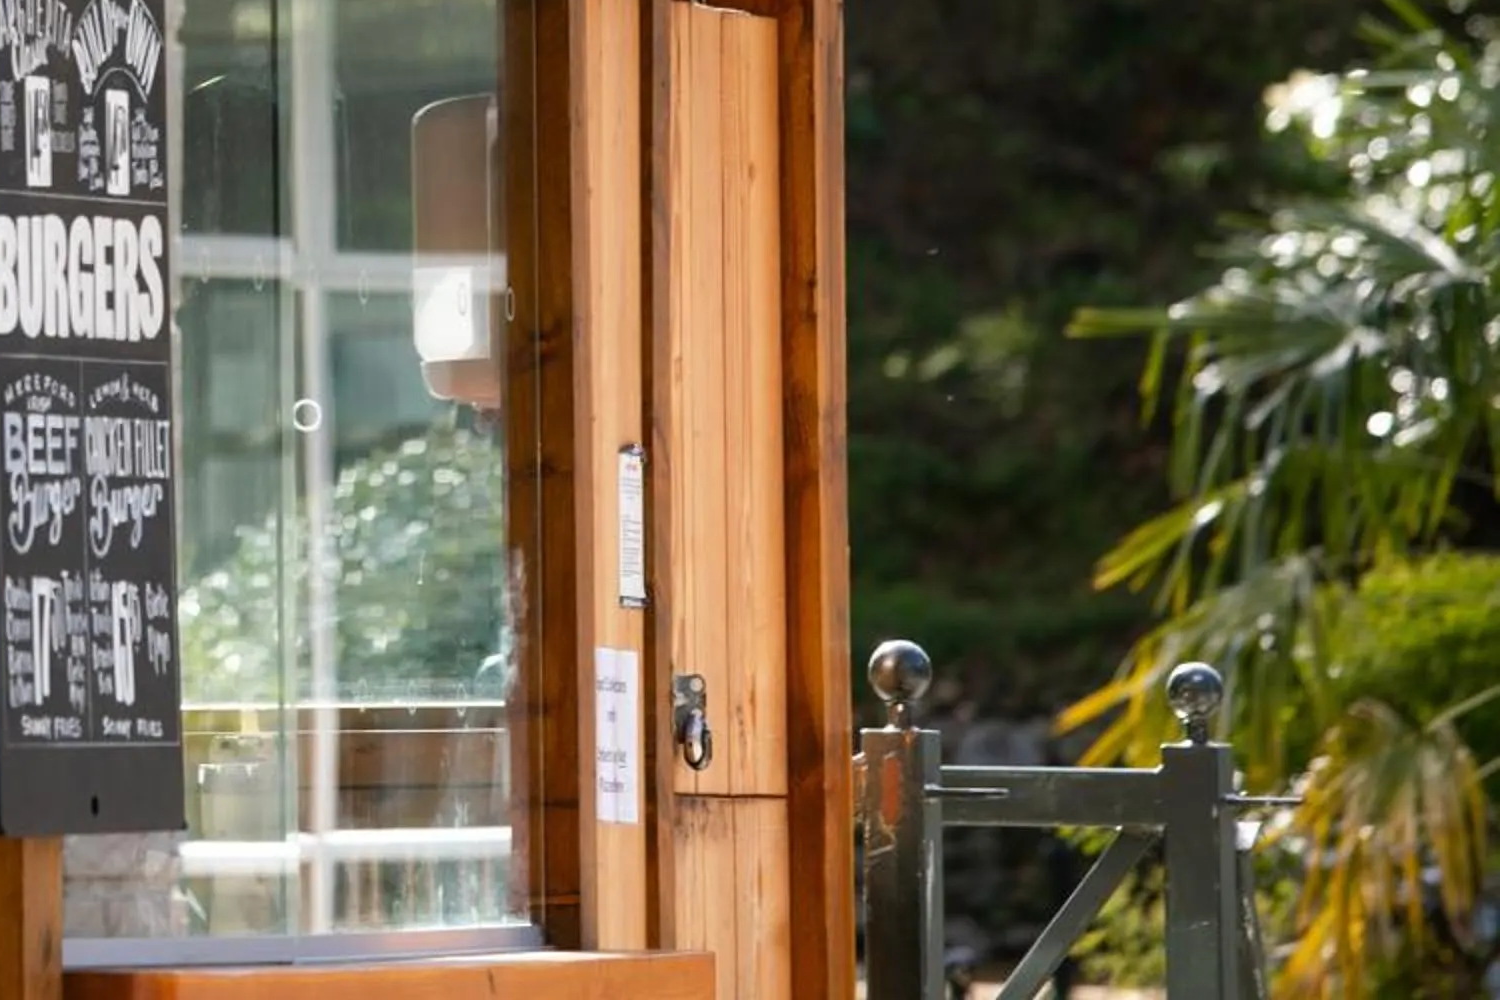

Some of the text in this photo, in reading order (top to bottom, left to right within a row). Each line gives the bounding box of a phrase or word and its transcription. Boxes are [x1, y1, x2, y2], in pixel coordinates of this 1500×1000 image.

[3, 411, 80, 475] BEEF
[8, 470, 81, 555] Burger
[89, 473, 164, 560] Burger
